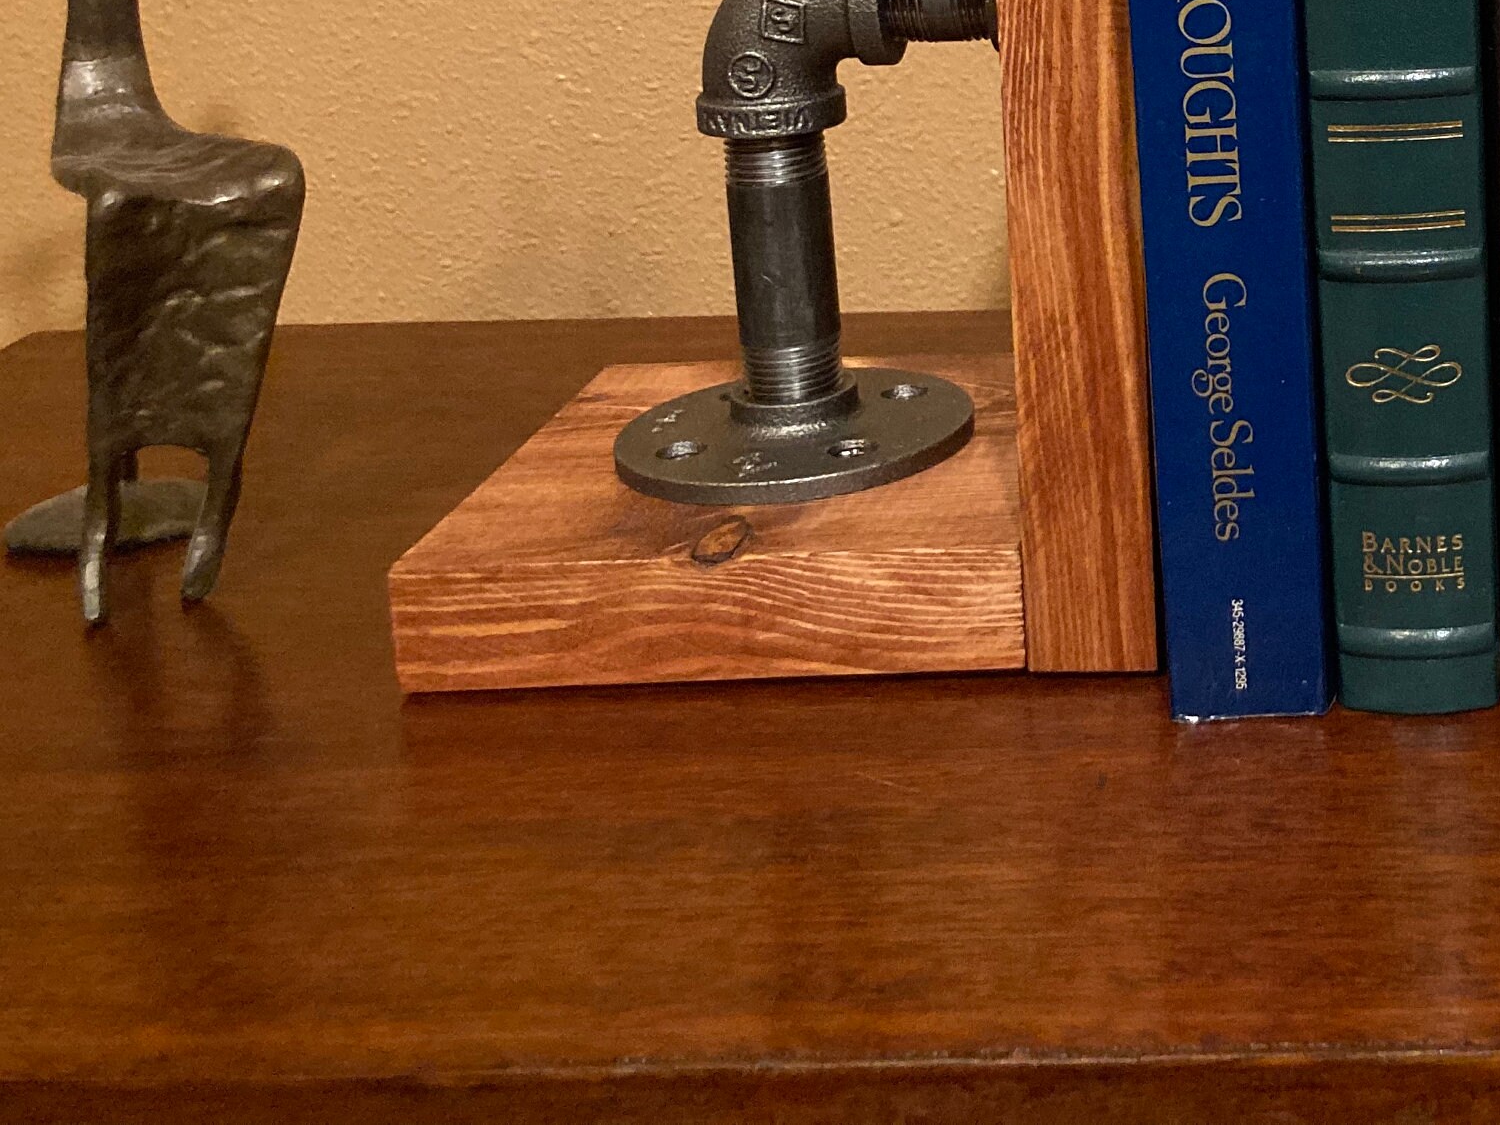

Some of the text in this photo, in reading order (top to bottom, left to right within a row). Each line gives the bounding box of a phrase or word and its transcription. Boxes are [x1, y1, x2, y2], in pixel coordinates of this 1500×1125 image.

[1191, 272, 1256, 542] George Seldes
[1362, 531, 1464, 554] BARNES
[1364, 577, 1465, 593] BOOKS
